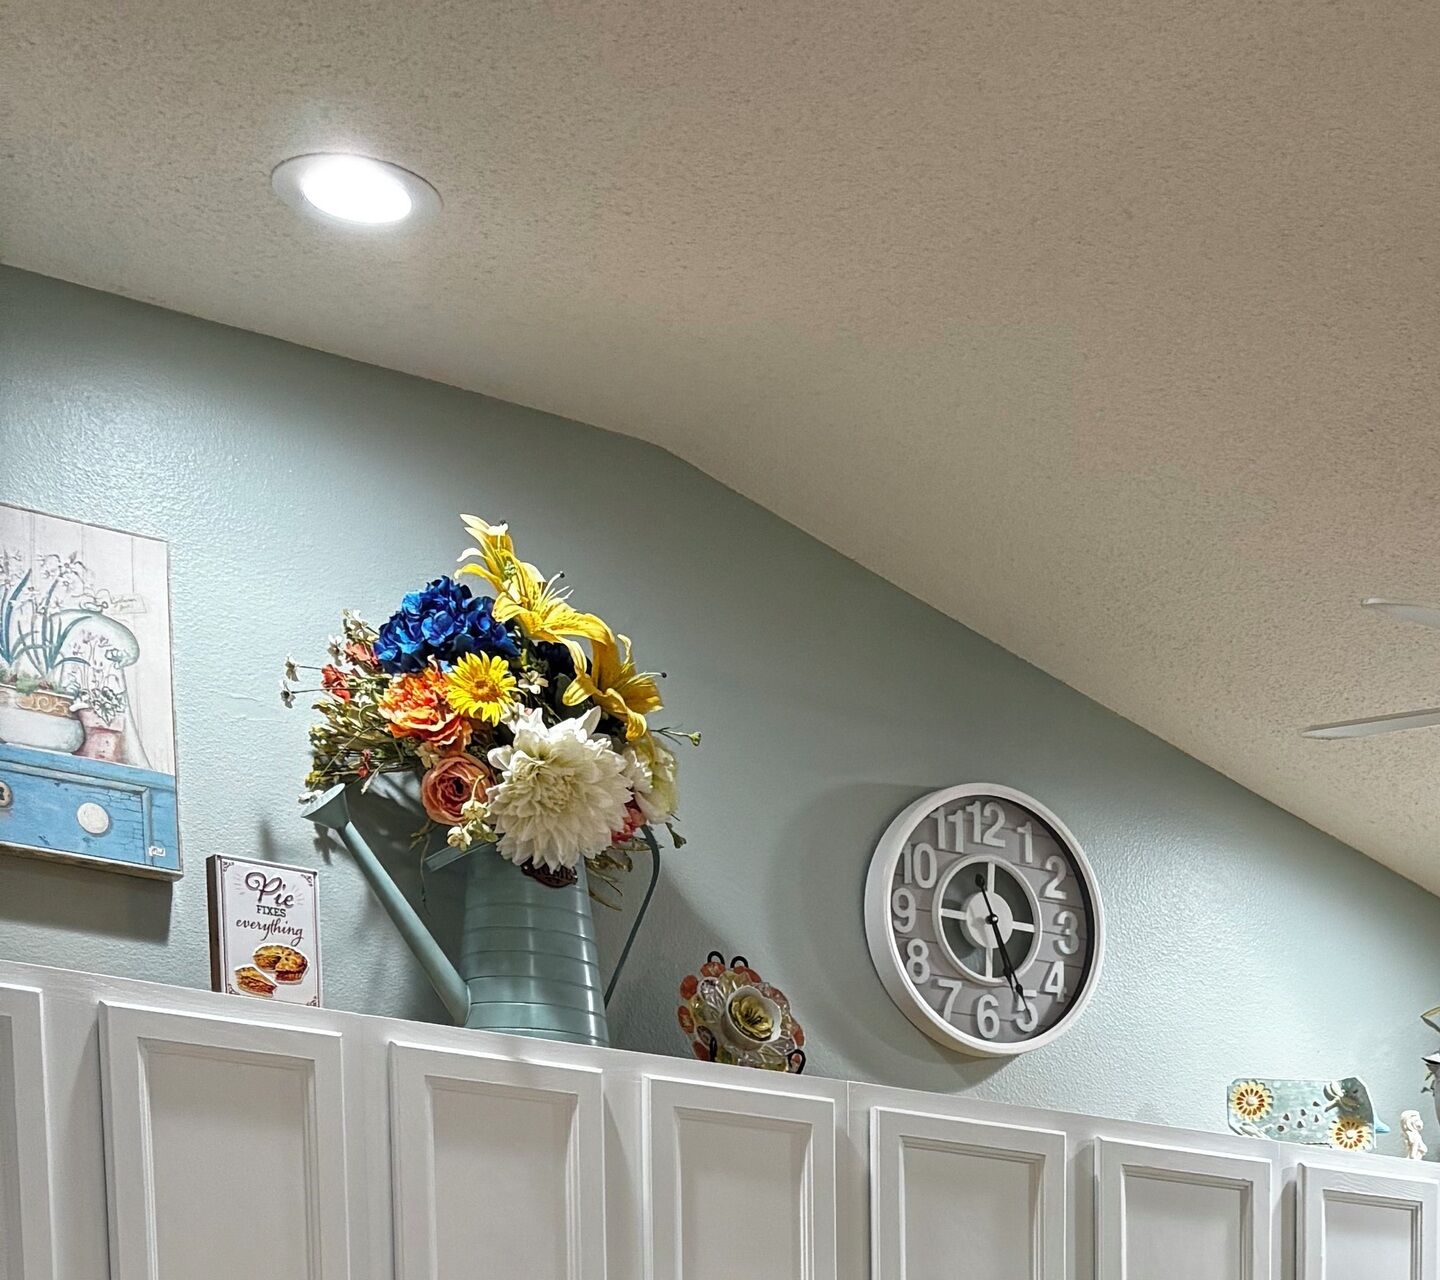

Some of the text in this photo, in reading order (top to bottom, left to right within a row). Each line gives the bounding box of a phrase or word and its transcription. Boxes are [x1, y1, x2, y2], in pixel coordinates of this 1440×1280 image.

[930, 806, 964, 853] 11
[966, 800, 1006, 848] 12
[1017, 821, 1033, 864] 1
[900, 842, 938, 889] 10
[1045, 856, 1067, 900] 2
[245, 871, 294, 909] Pie
[256, 905, 287, 918] FIXES
[892, 887, 916, 933] 9
[236, 918, 304, 947] everything
[1057, 911, 1079, 955] 3
[906, 938, 931, 984] 8
[1045, 960, 1067, 1003] 4
[938, 979, 963, 1020] 7
[977, 994, 1000, 1039] 6
[1016, 989, 1039, 1033] 5
